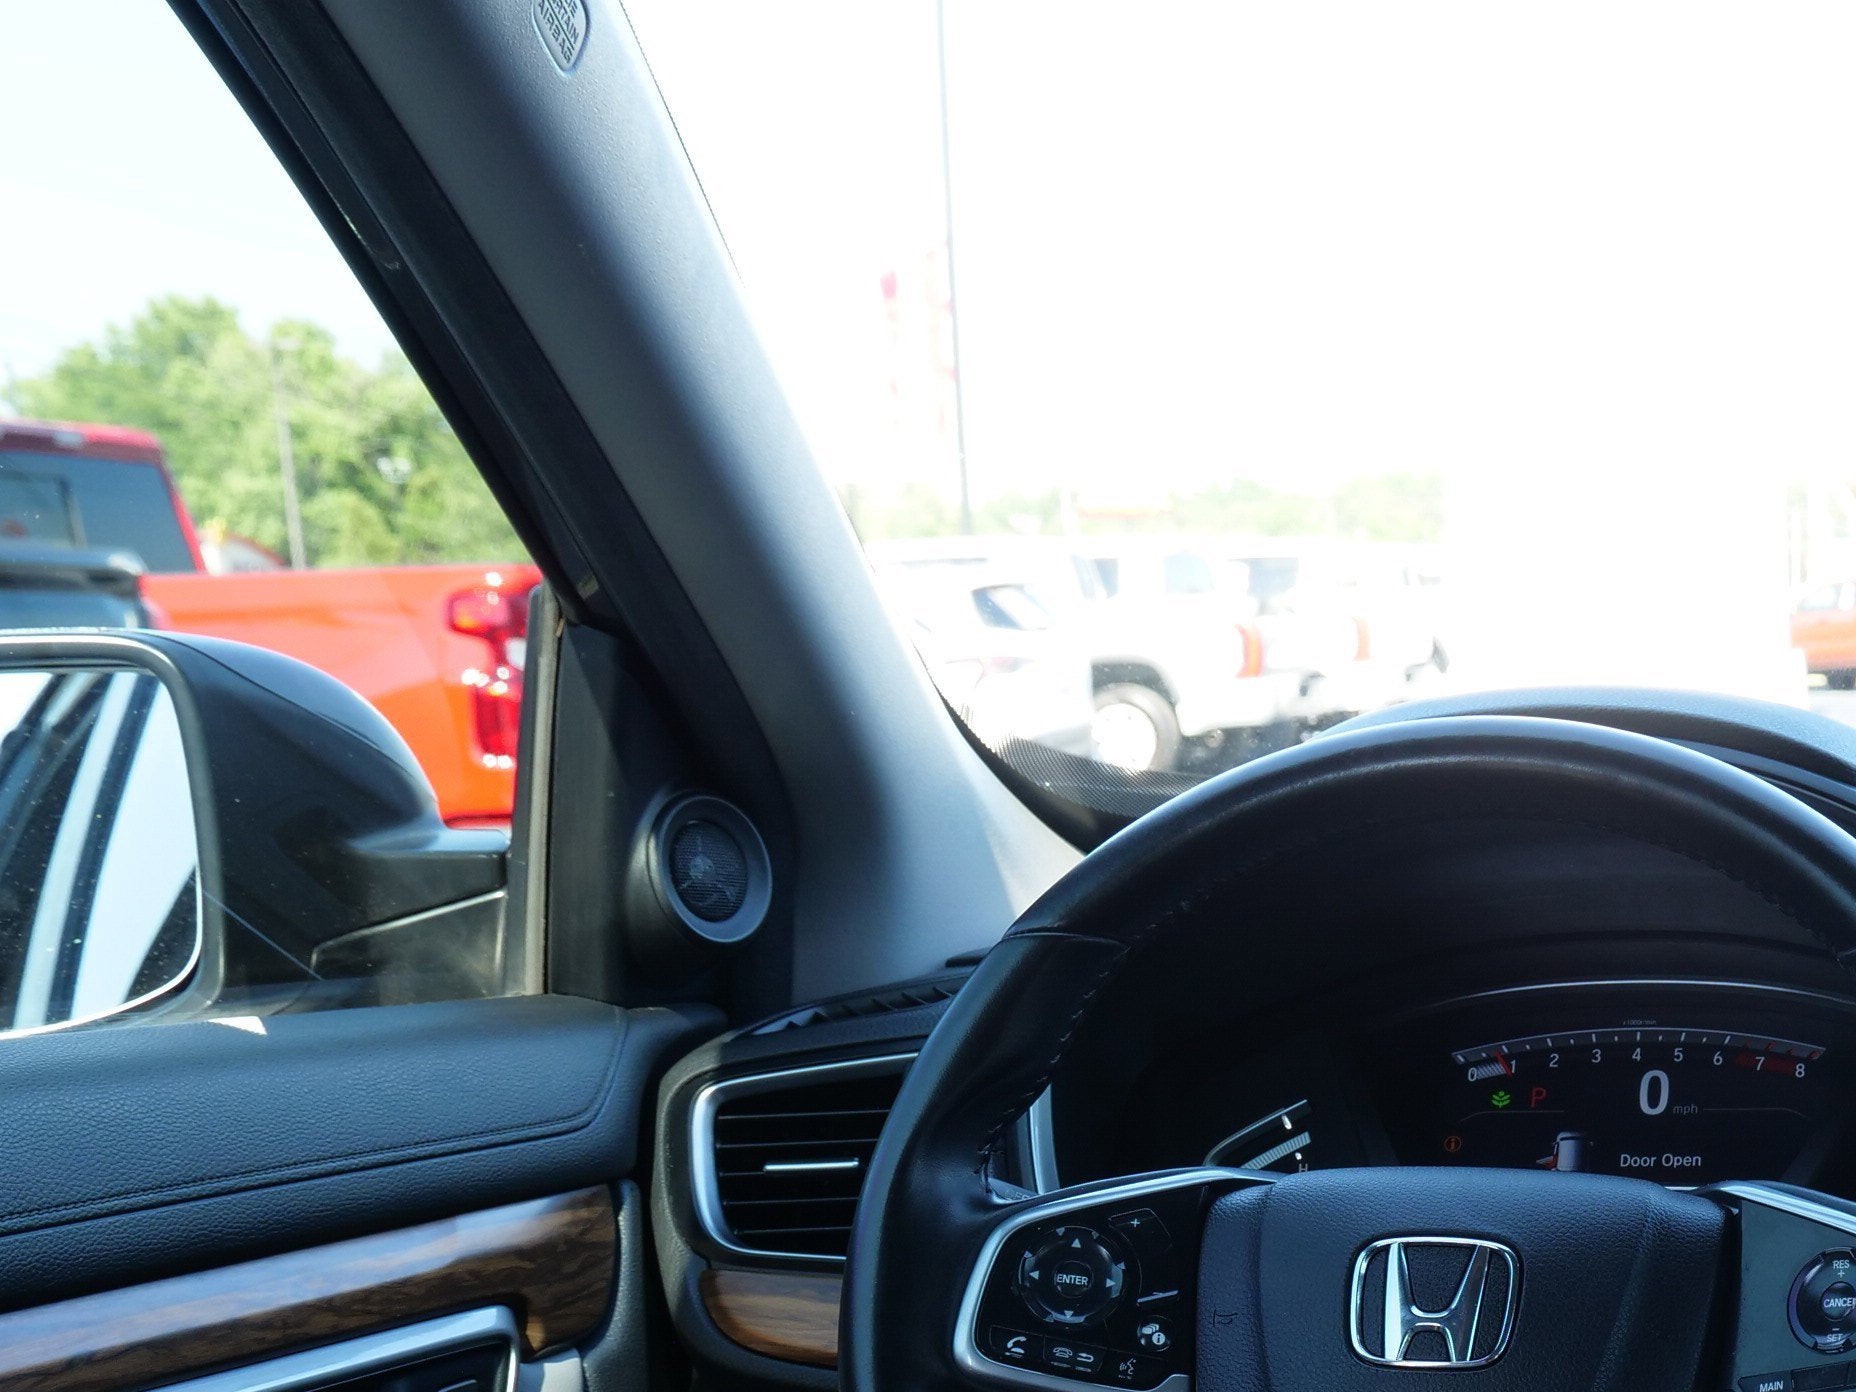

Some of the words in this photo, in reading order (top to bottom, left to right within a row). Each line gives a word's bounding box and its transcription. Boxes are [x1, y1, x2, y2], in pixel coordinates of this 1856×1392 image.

[552, 0, 579, 45] RTAIN
[1467, 1067, 1477, 1083] 0
[1510, 1060, 1517, 1074] 1
[1549, 1053, 1560, 1068] 2
[1591, 1050, 1601, 1064] 3
[1632, 1049, 1642, 1062] 4
[1673, 1049, 1683, 1063] 5
[1712, 1051, 1723, 1065] 6
[1755, 1057, 1765, 1071] 7
[1794, 1064, 1805, 1078] 8
[1530, 1086, 1547, 1108] P
[1638, 1069, 1670, 1115] 0
[1672, 1102, 1699, 1117] mph
[1619, 1153, 1657, 1168] Door
[1661, 1153, 1701, 1171] Open
[1832, 1259, 1850, 1270] RES
[1056, 1273, 1089, 1287] ENTER
[1826, 1333, 1843, 1343] SET
